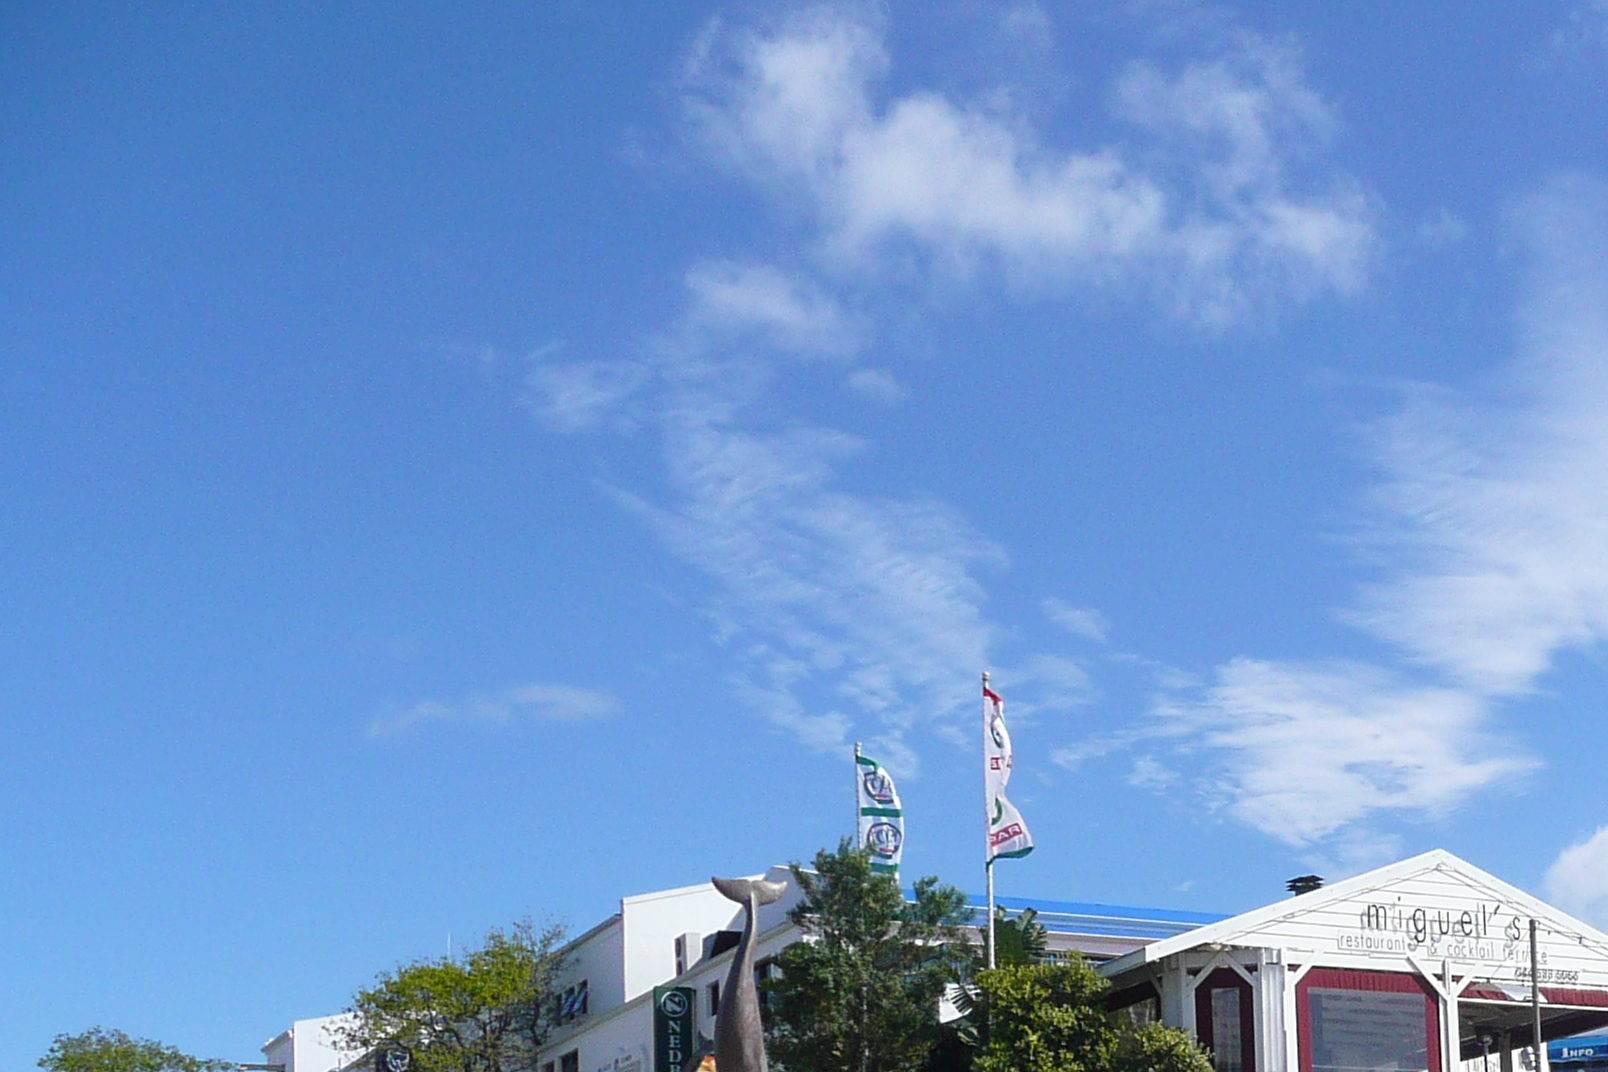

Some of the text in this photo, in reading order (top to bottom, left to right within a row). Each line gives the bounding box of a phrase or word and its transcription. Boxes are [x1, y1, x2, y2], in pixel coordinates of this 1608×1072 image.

[988, 825, 1021, 843] PAR
[1366, 895, 1522, 943] miguel's
[1502, 946, 1548, 964] terrce
